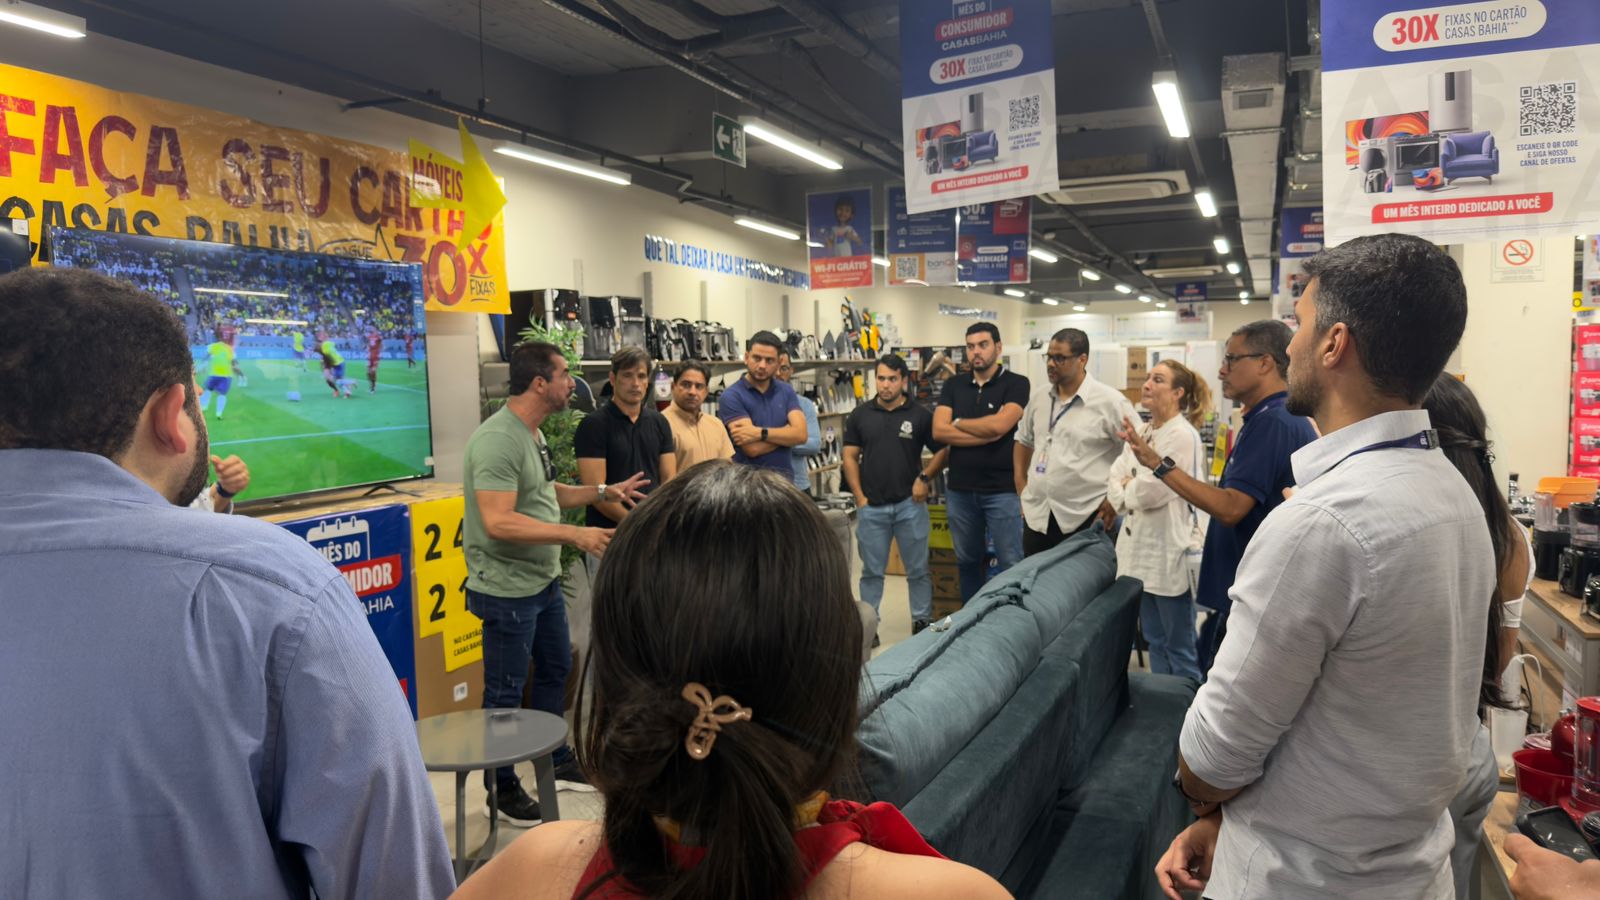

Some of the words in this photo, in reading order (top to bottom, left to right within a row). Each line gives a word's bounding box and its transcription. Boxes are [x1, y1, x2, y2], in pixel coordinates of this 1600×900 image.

[975, 2, 986, 13] DO
[1444, 13, 1471, 27] FIXAS
[1474, 11, 1487, 23] NO
[1489, 5, 1527, 22] CARTÃO
[941, 12, 1007, 37] CONSUMIDOR
[1391, 13, 1440, 46] 30X
[1445, 25, 1476, 40] CASAS
[940, 58, 966, 81] 30X
[0, 93, 191, 203] FAÇA
[219, 138, 331, 219] SEU
[1516, 143, 1545, 151] ESCANEIE
[1552, 141, 1561, 149] QR
[1562, 140, 1579, 148] CODE
[1520, 159, 1539, 167] CANAL
[1550, 156, 1577, 165] OFERTAS
[412, 153, 464, 203] MÓVEIS
[1383, 207, 1398, 219] UM
[1400, 204, 1420, 217] MÊS
[1421, 203, 1457, 216] INTEIRO
[1458, 199, 1506, 213] DEDICADO
[1507, 199, 1515, 210] A
[1516, 195, 1541, 210] VOCÊ
[645, 235, 662, 262] QUE
[664, 239, 679, 265] TAL
[681, 243, 708, 270] DEIXAR
[710, 250, 715, 271] A
[716, 252, 733, 274] CASA
[344, 540, 361, 560] DO
[454, 635, 462, 645] NO
[454, 644, 470, 656] CASAS
